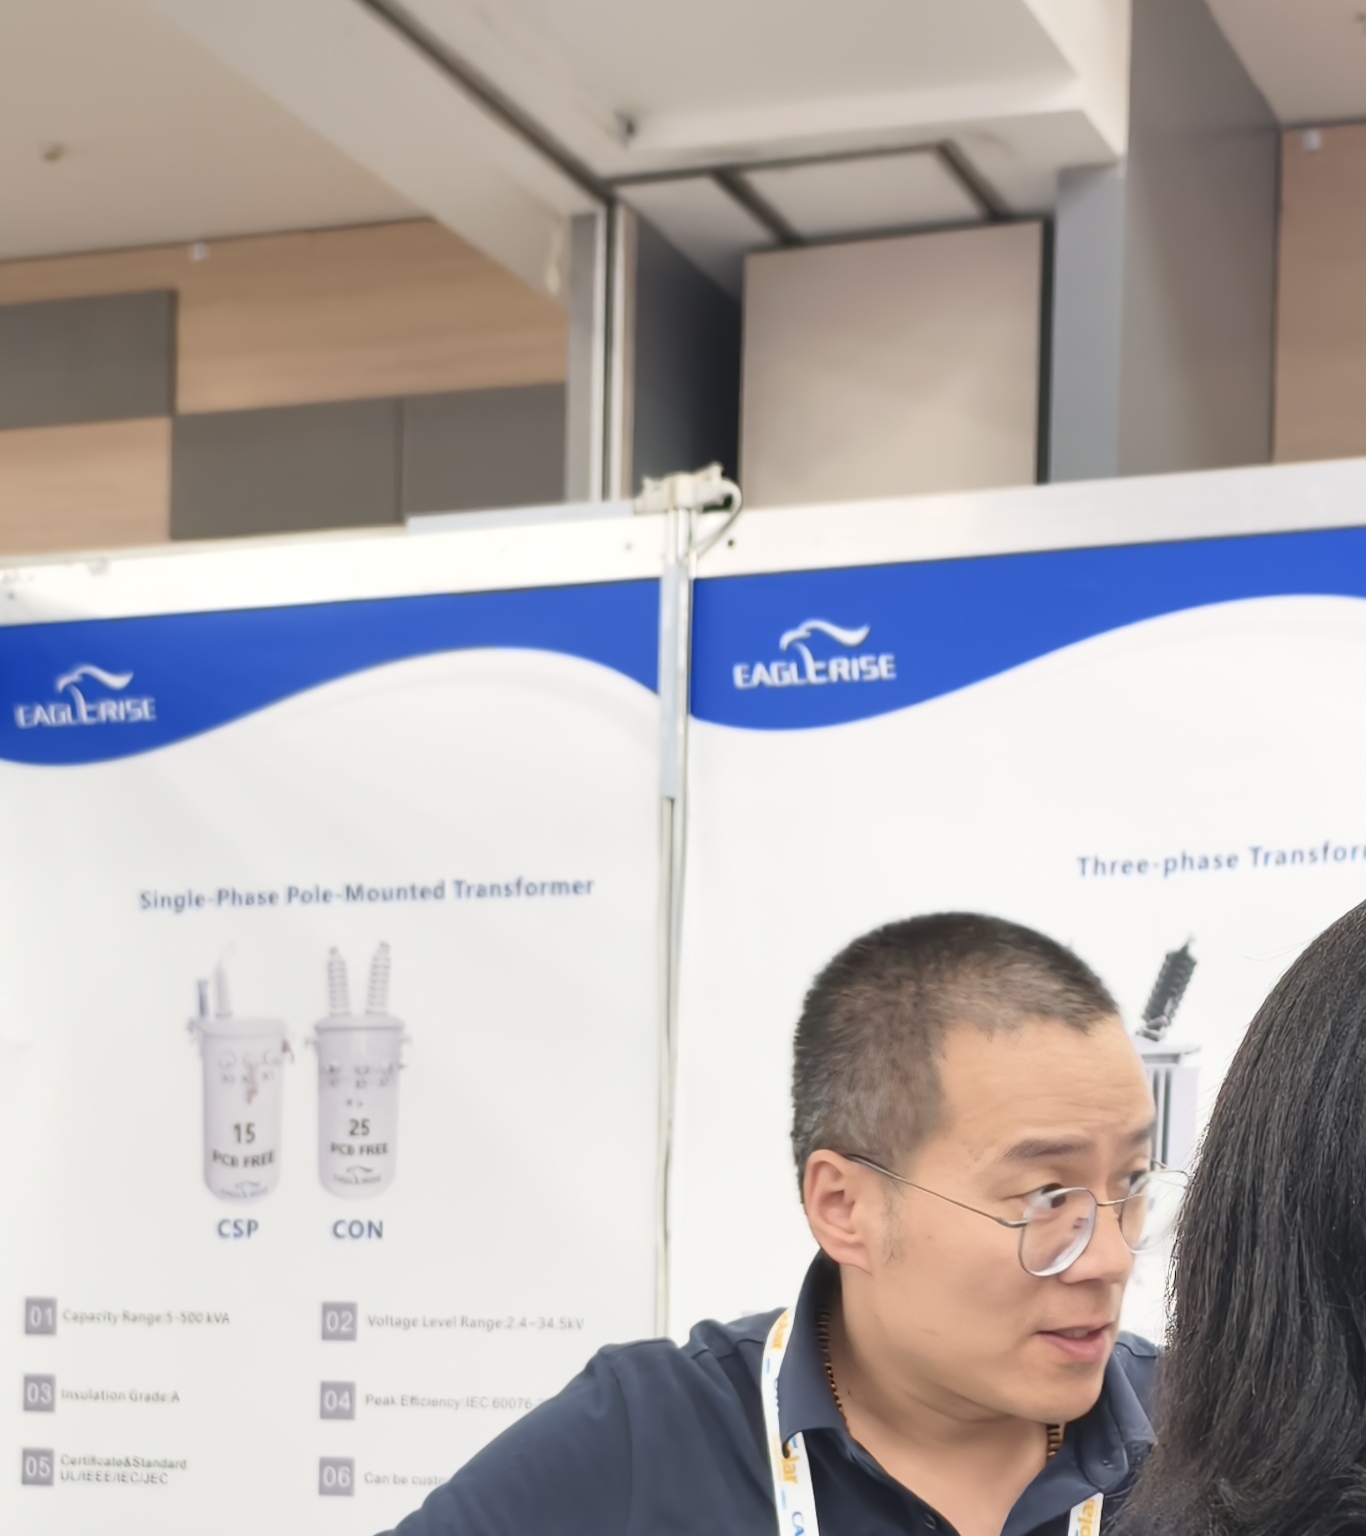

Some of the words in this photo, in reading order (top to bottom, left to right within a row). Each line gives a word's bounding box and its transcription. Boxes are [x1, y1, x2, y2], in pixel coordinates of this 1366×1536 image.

[733, 654, 897, 689] EAGLERISE
[14, 696, 156, 729] EAGLERISE
[1076, 851, 1240, 879] Three-phase
[138, 887, 280, 914] Single-Phase
[286, 880, 446, 907] Pole-Mounted
[451, 875, 595, 900] Transformer
[232, 1121, 256, 1144] 15
[349, 1117, 371, 1137] 25
[359, 1142, 389, 1156] FREE
[217, 1218, 260, 1239] CSP
[332, 1218, 384, 1239] CON
[29, 1304, 54, 1328] 01
[62, 1308, 119, 1326] Capacity
[206, 1311, 231, 1325] kVA
[325, 1310, 354, 1332] 02
[367, 1314, 419, 1331] Voltage
[422, 1314, 457, 1328] Level
[26, 1381, 53, 1405] 03
[60, 1388, 126, 1402] Insulation
[323, 1389, 352, 1411] 04
[365, 1393, 398, 1407] Peak
[24, 1455, 51, 1478] 05
[322, 1465, 352, 1488] 06
[364, 1472, 390, 1486] Can
[393, 1472, 409, 1486] be
[411, 1473, 451, 1488] custo
